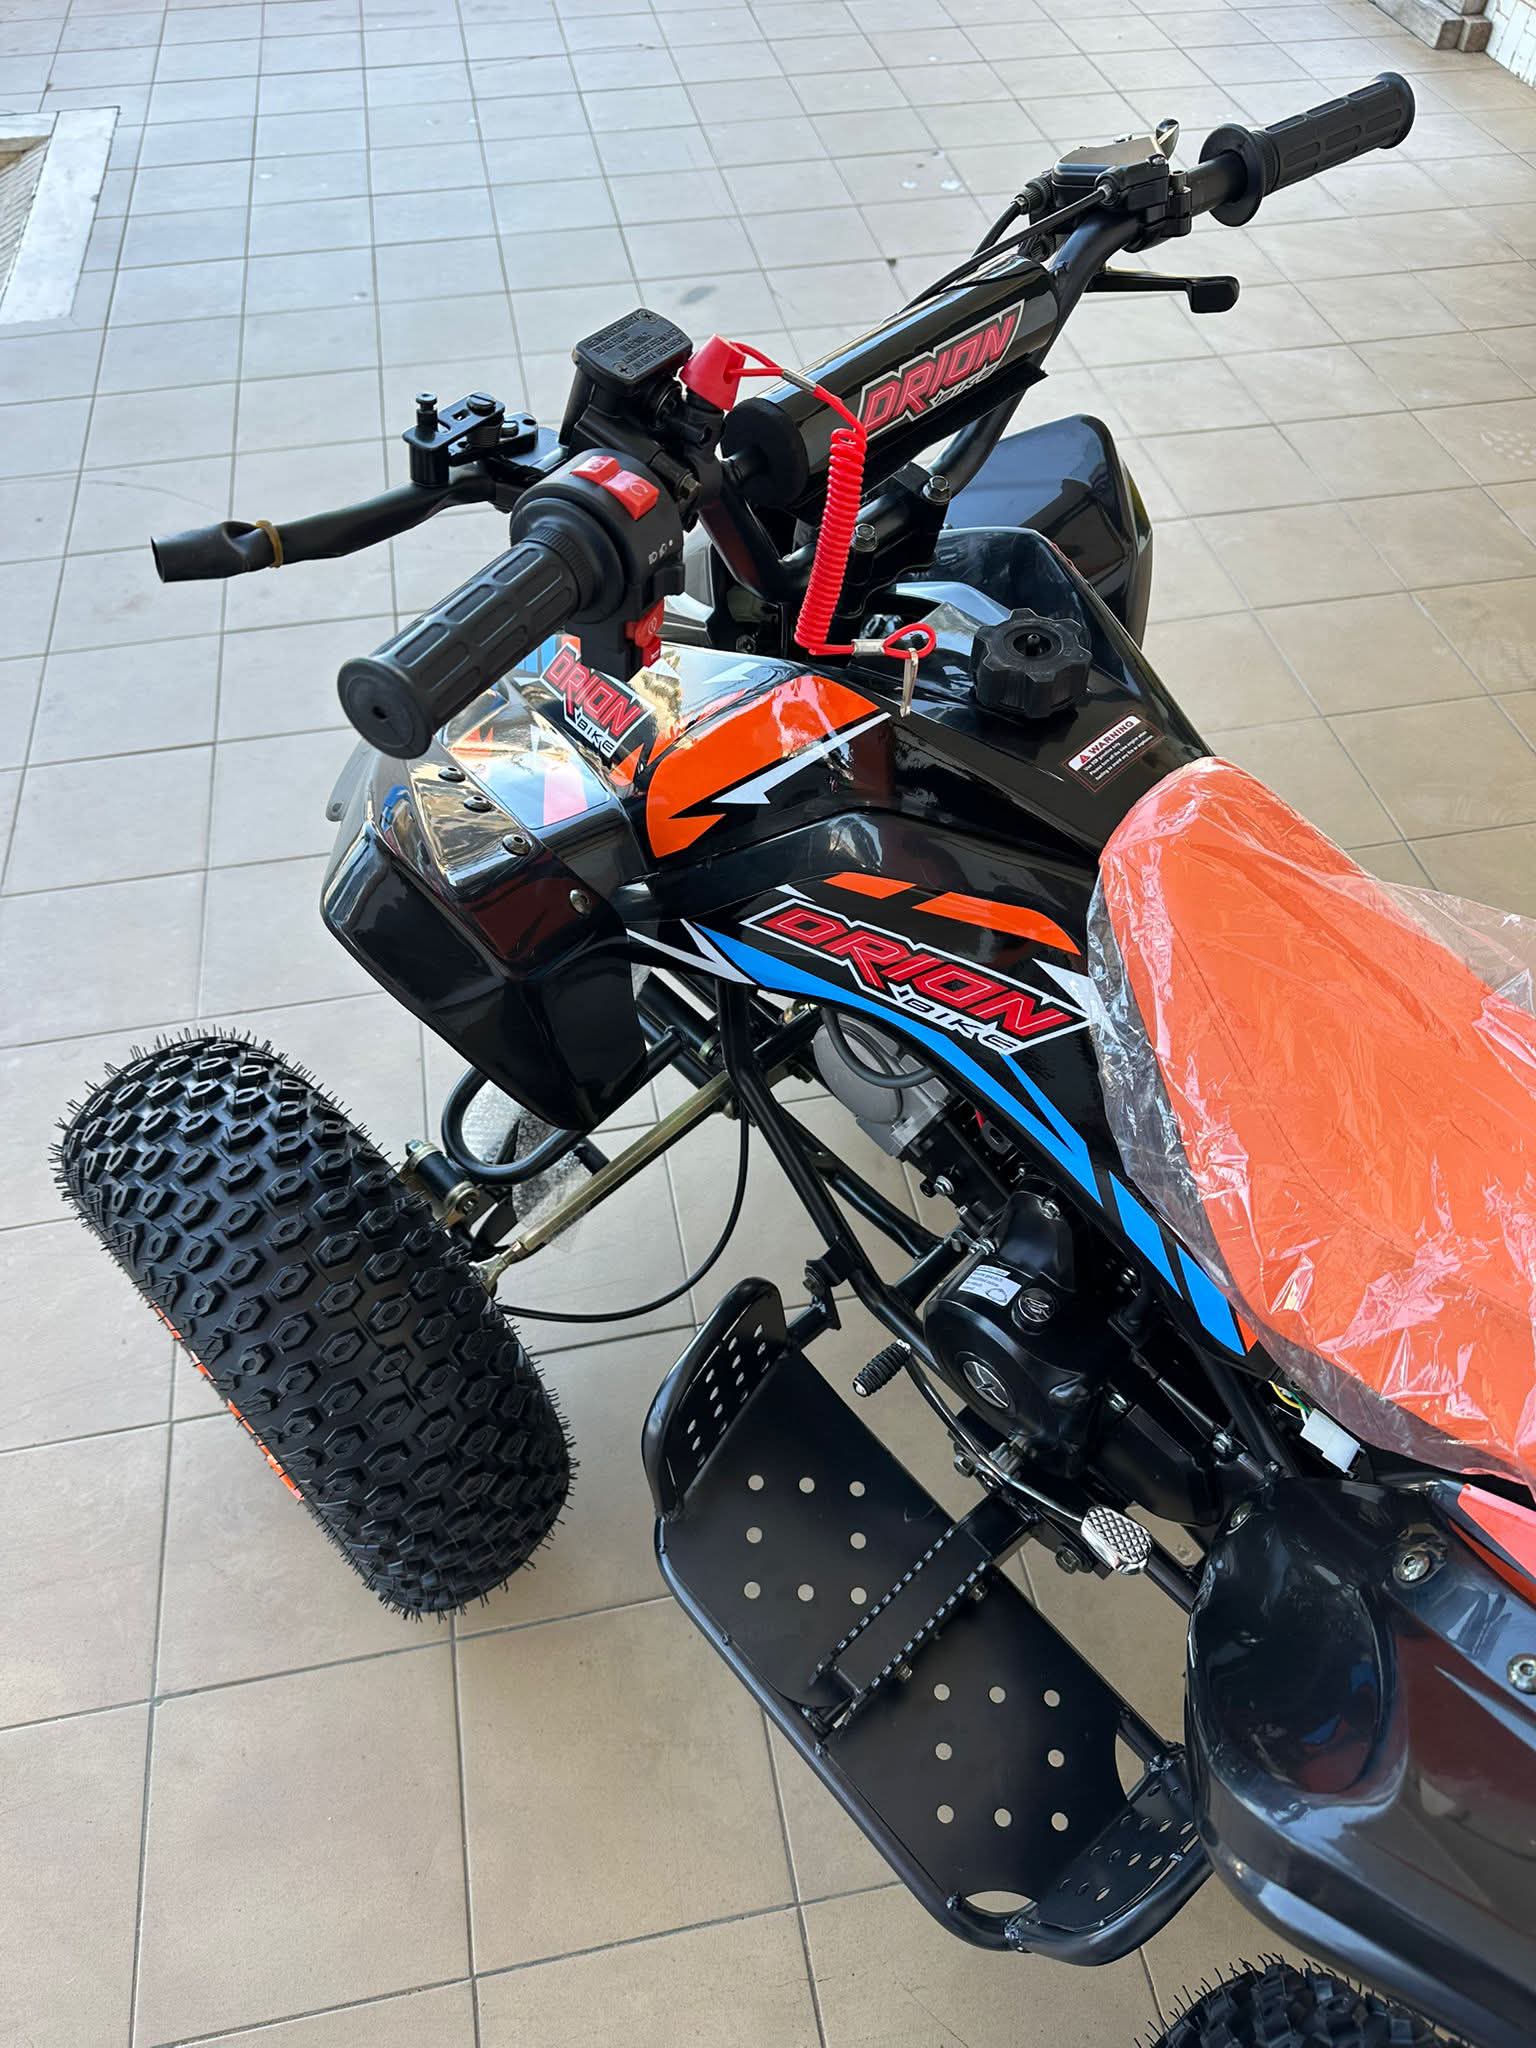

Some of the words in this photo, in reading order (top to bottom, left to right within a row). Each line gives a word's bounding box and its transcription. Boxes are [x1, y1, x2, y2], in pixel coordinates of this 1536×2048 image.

[577, 721, 616, 754] BIKE
[1089, 721, 1135, 755] WARNING
[903, 998, 1018, 1050] BIKE
